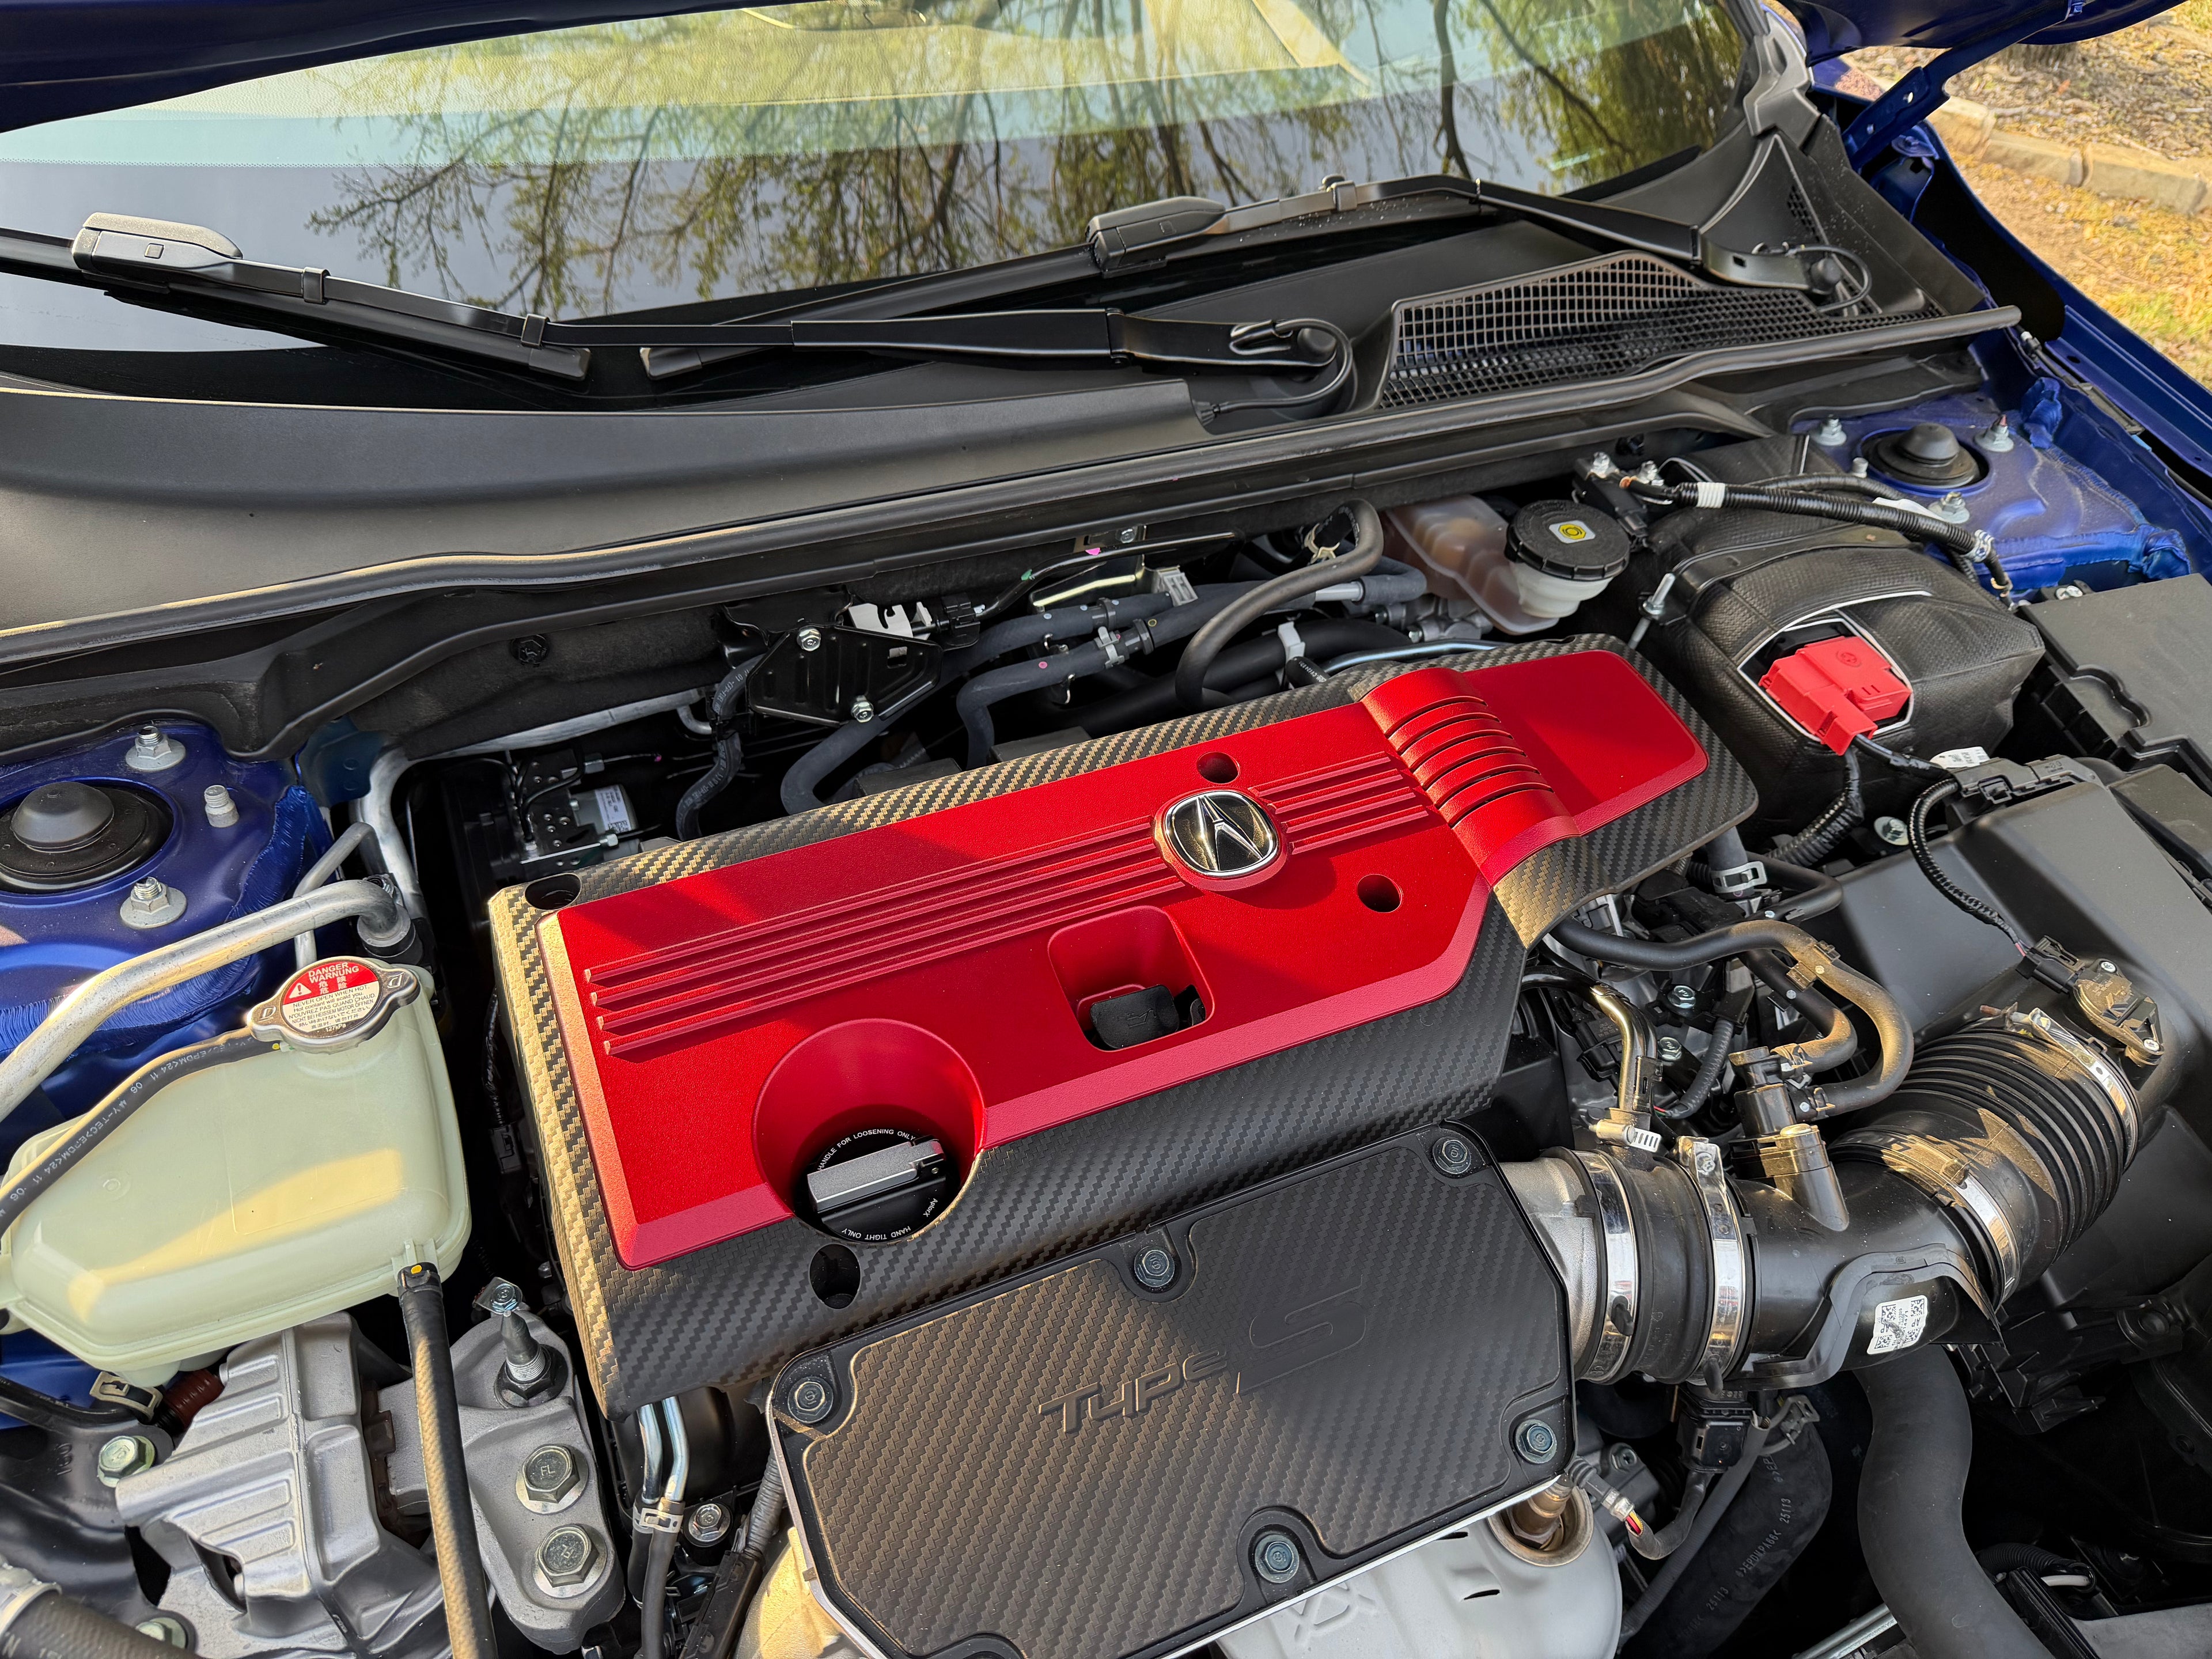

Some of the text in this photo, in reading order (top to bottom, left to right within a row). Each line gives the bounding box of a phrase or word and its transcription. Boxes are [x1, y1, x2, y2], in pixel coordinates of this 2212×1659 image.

[308, 962, 349, 978] DANGER
[309, 965, 359, 983] WARNUNG
[293, 999, 315, 1008] NEVER
[316, 994, 333, 1002] OPEN
[335, 988, 353, 997] WHEN
[305, 1001, 325, 1010] coolant
[289, 1007, 319, 1020] N'OUVREZ
[332, 999, 353, 1007] QUAND
[316, 1008, 336, 1018] HEISSEM
[337, 1004, 354, 1012] MOTOR
[325, 1023, 347, 1033] 127kPa
[130, 1081, 143, 1094] 06
[817, 1128, 916, 1171] HANDLE FOR LOOSENING ONLY
[10, 1188, 25, 1201] 06
[841, 1226, 911, 1241] HAND TIGHT ONLY
[1779, 1498, 1792, 1524] 25113
